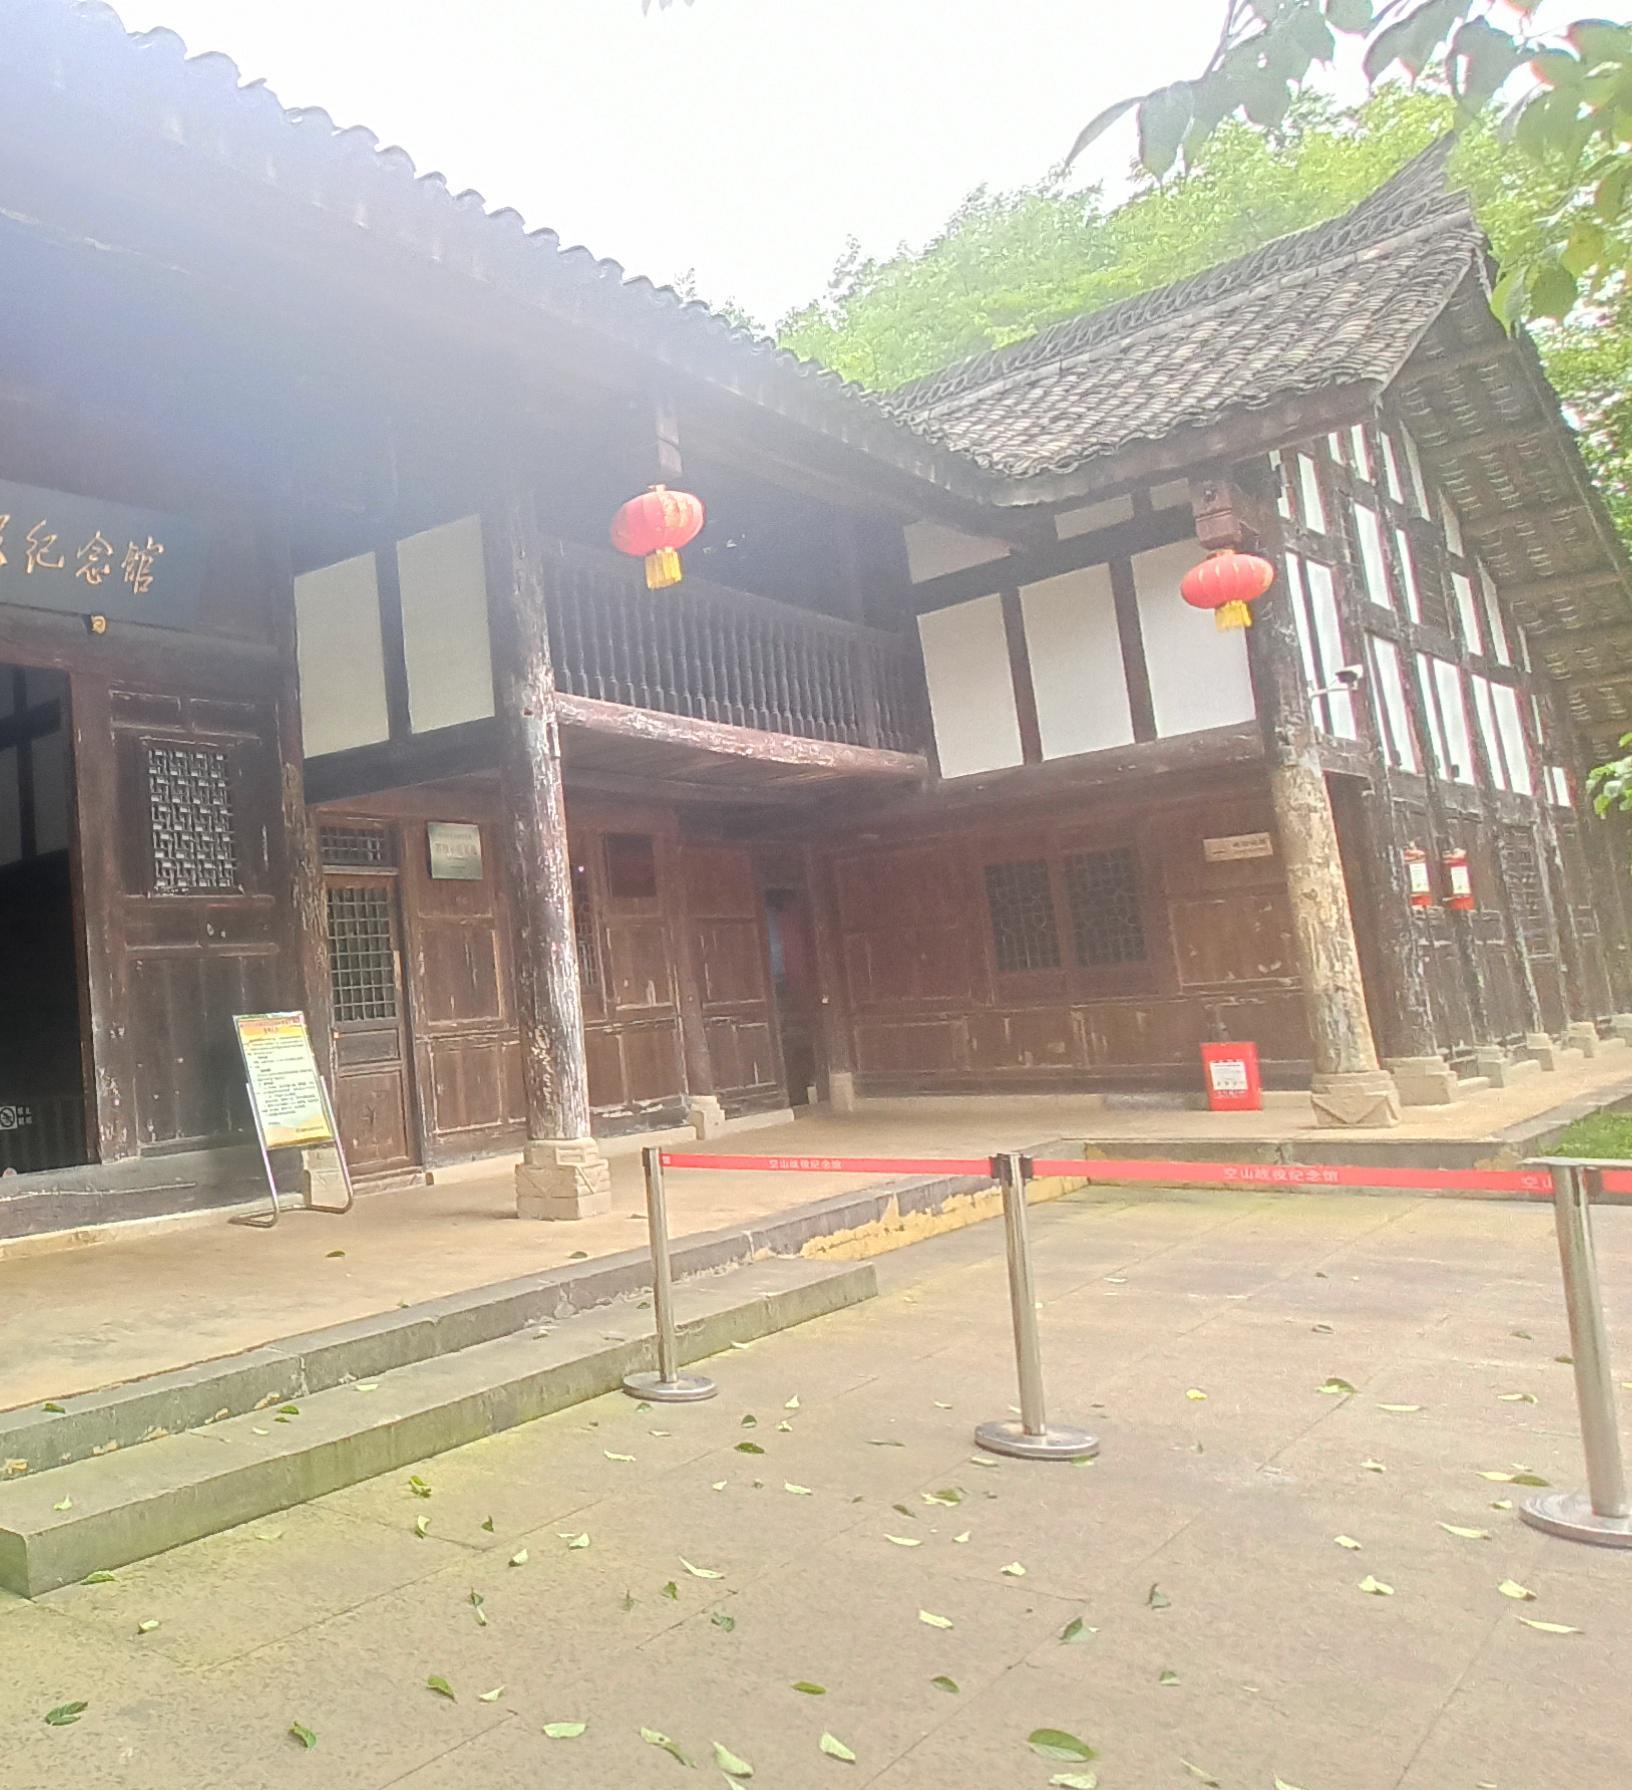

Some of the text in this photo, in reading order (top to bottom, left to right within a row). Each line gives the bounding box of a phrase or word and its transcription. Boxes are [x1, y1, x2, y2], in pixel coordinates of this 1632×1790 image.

[1224, 1168, 1339, 1182] 空山战役纪念馆
